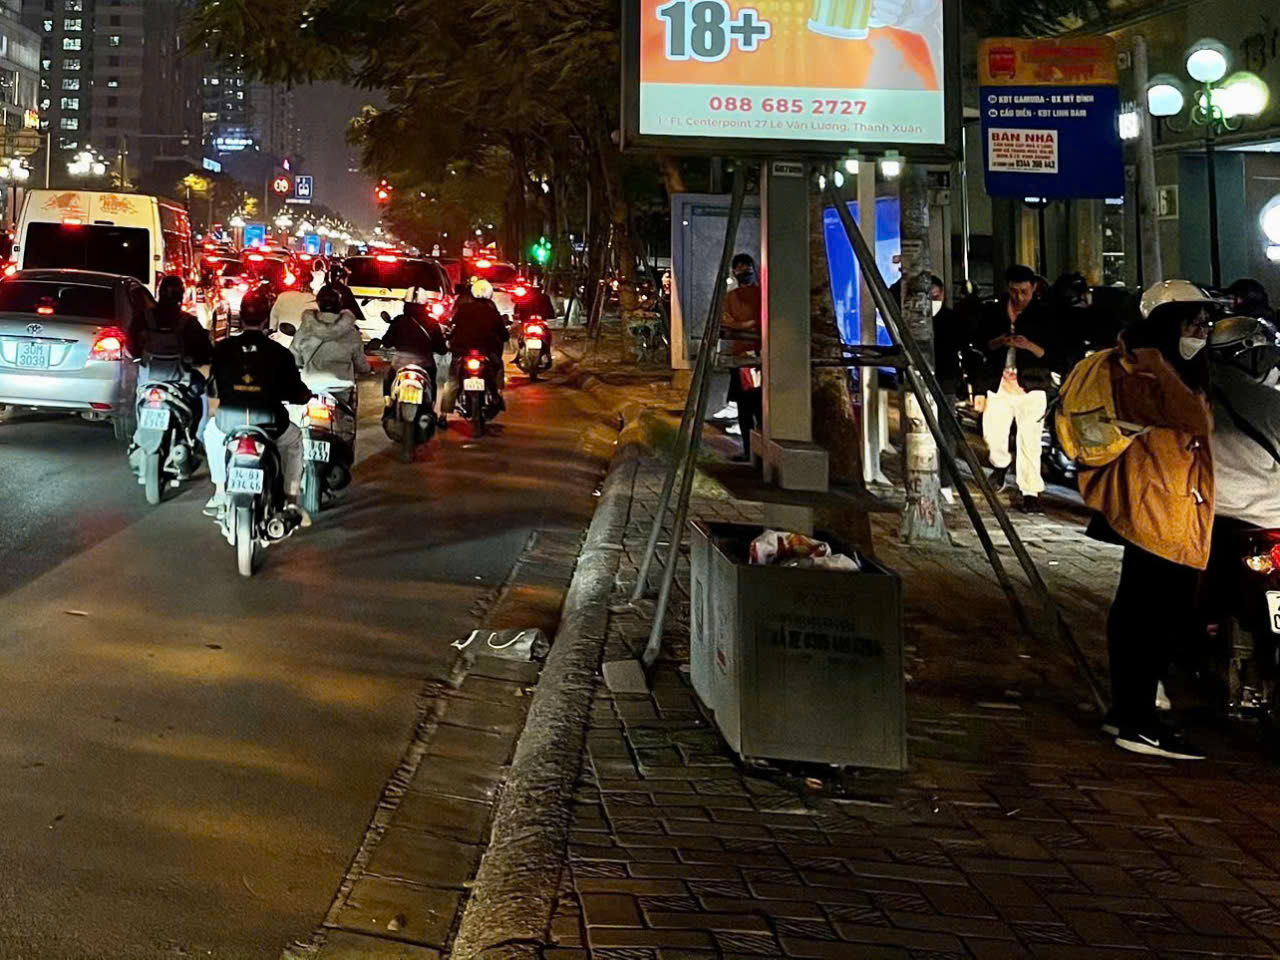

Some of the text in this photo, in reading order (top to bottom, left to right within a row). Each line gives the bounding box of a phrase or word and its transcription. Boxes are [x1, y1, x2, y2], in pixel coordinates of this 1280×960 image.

[660, 0, 766, 58] 18+
[709, 96, 867, 115] 088 685 2727
[686, 117, 753, 130] Centerpoint
[754, 119, 768, 128] 27
[854, 123, 889, 132] Thanh
[1025, 132, 1055, 144] NHÀ
